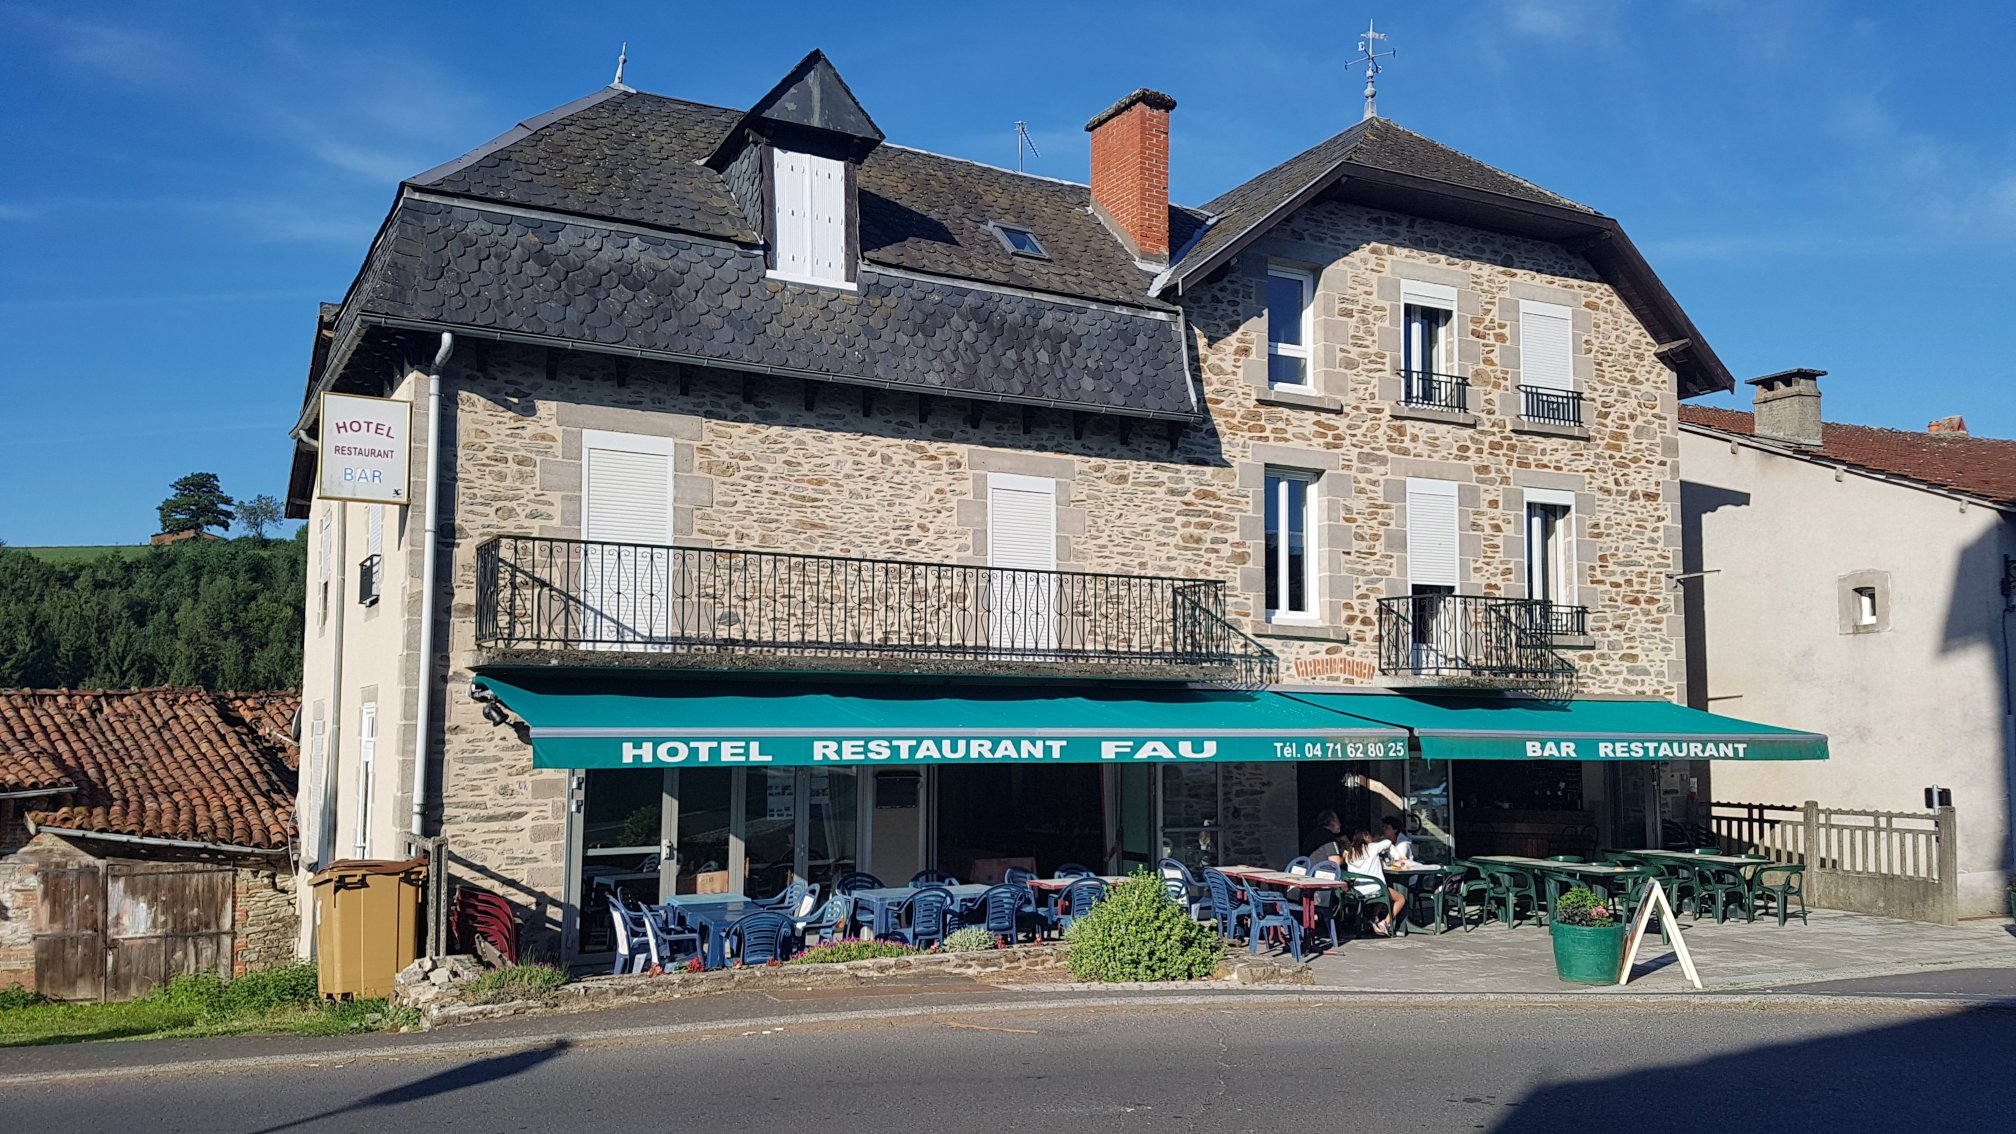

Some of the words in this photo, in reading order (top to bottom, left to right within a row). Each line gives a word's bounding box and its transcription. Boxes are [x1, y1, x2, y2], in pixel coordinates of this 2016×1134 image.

[335, 420, 395, 439] HOTEL
[334, 445, 395, 459] RESTAURANT
[343, 467, 382, 484] BAR
[621, 741, 773, 764] HOTEL
[813, 739, 1067, 761] RESTAURANT
[1100, 740, 1217, 759] FAU
[1273, 741, 1301, 759] Tél.
[1304, 742, 1323, 758] 04
[1325, 742, 1342, 758] 71
[1346, 743, 1365, 758] 62
[1366, 743, 1385, 758] 80
[1387, 742, 1405, 757] 25
[1525, 741, 1578, 758] BAR
[1598, 741, 1748, 758] RESTAURANT
